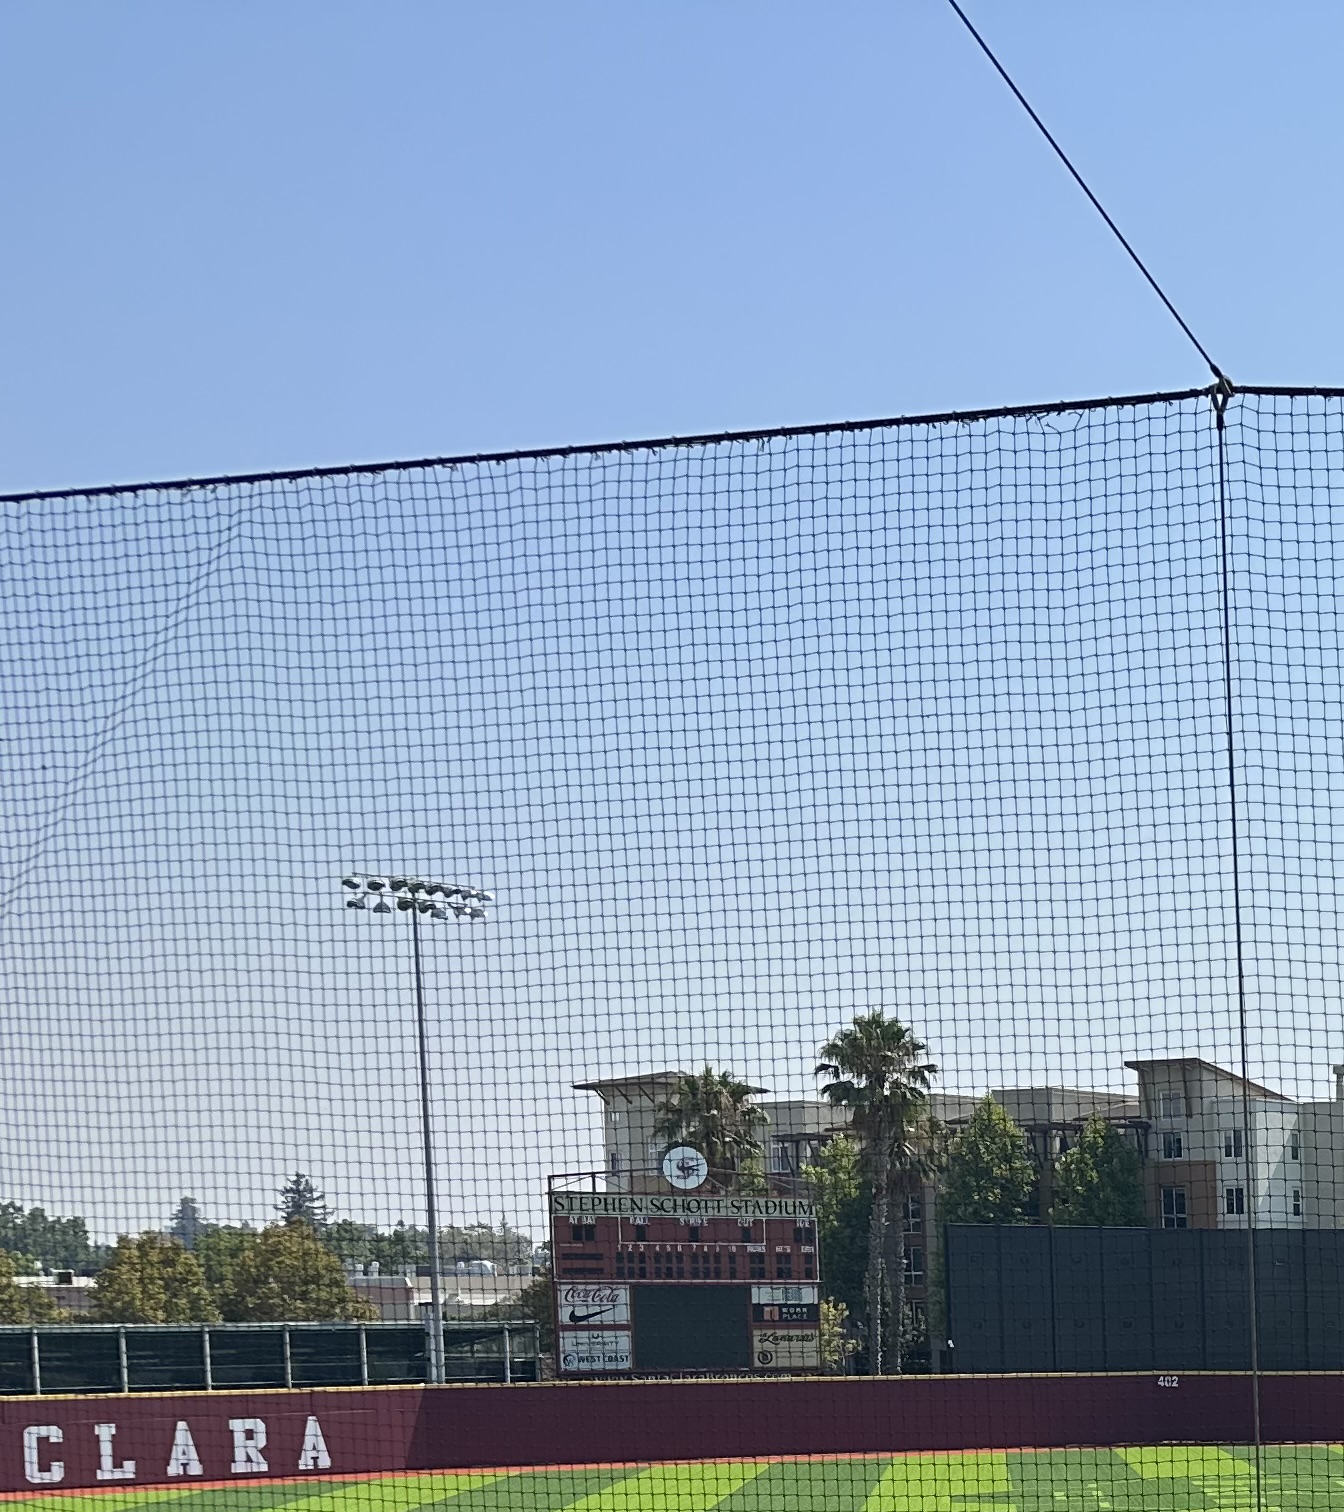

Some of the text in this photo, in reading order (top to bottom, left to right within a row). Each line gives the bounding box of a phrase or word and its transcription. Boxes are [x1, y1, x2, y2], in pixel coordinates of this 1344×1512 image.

[554, 1195, 814, 1215] STEPHEN SCHOTT STADIUM
[578, 1354, 629, 1364] WEST COAST
[1157, 1375, 1179, 1388] 402
[23, 1415, 332, 1483] CLARA
